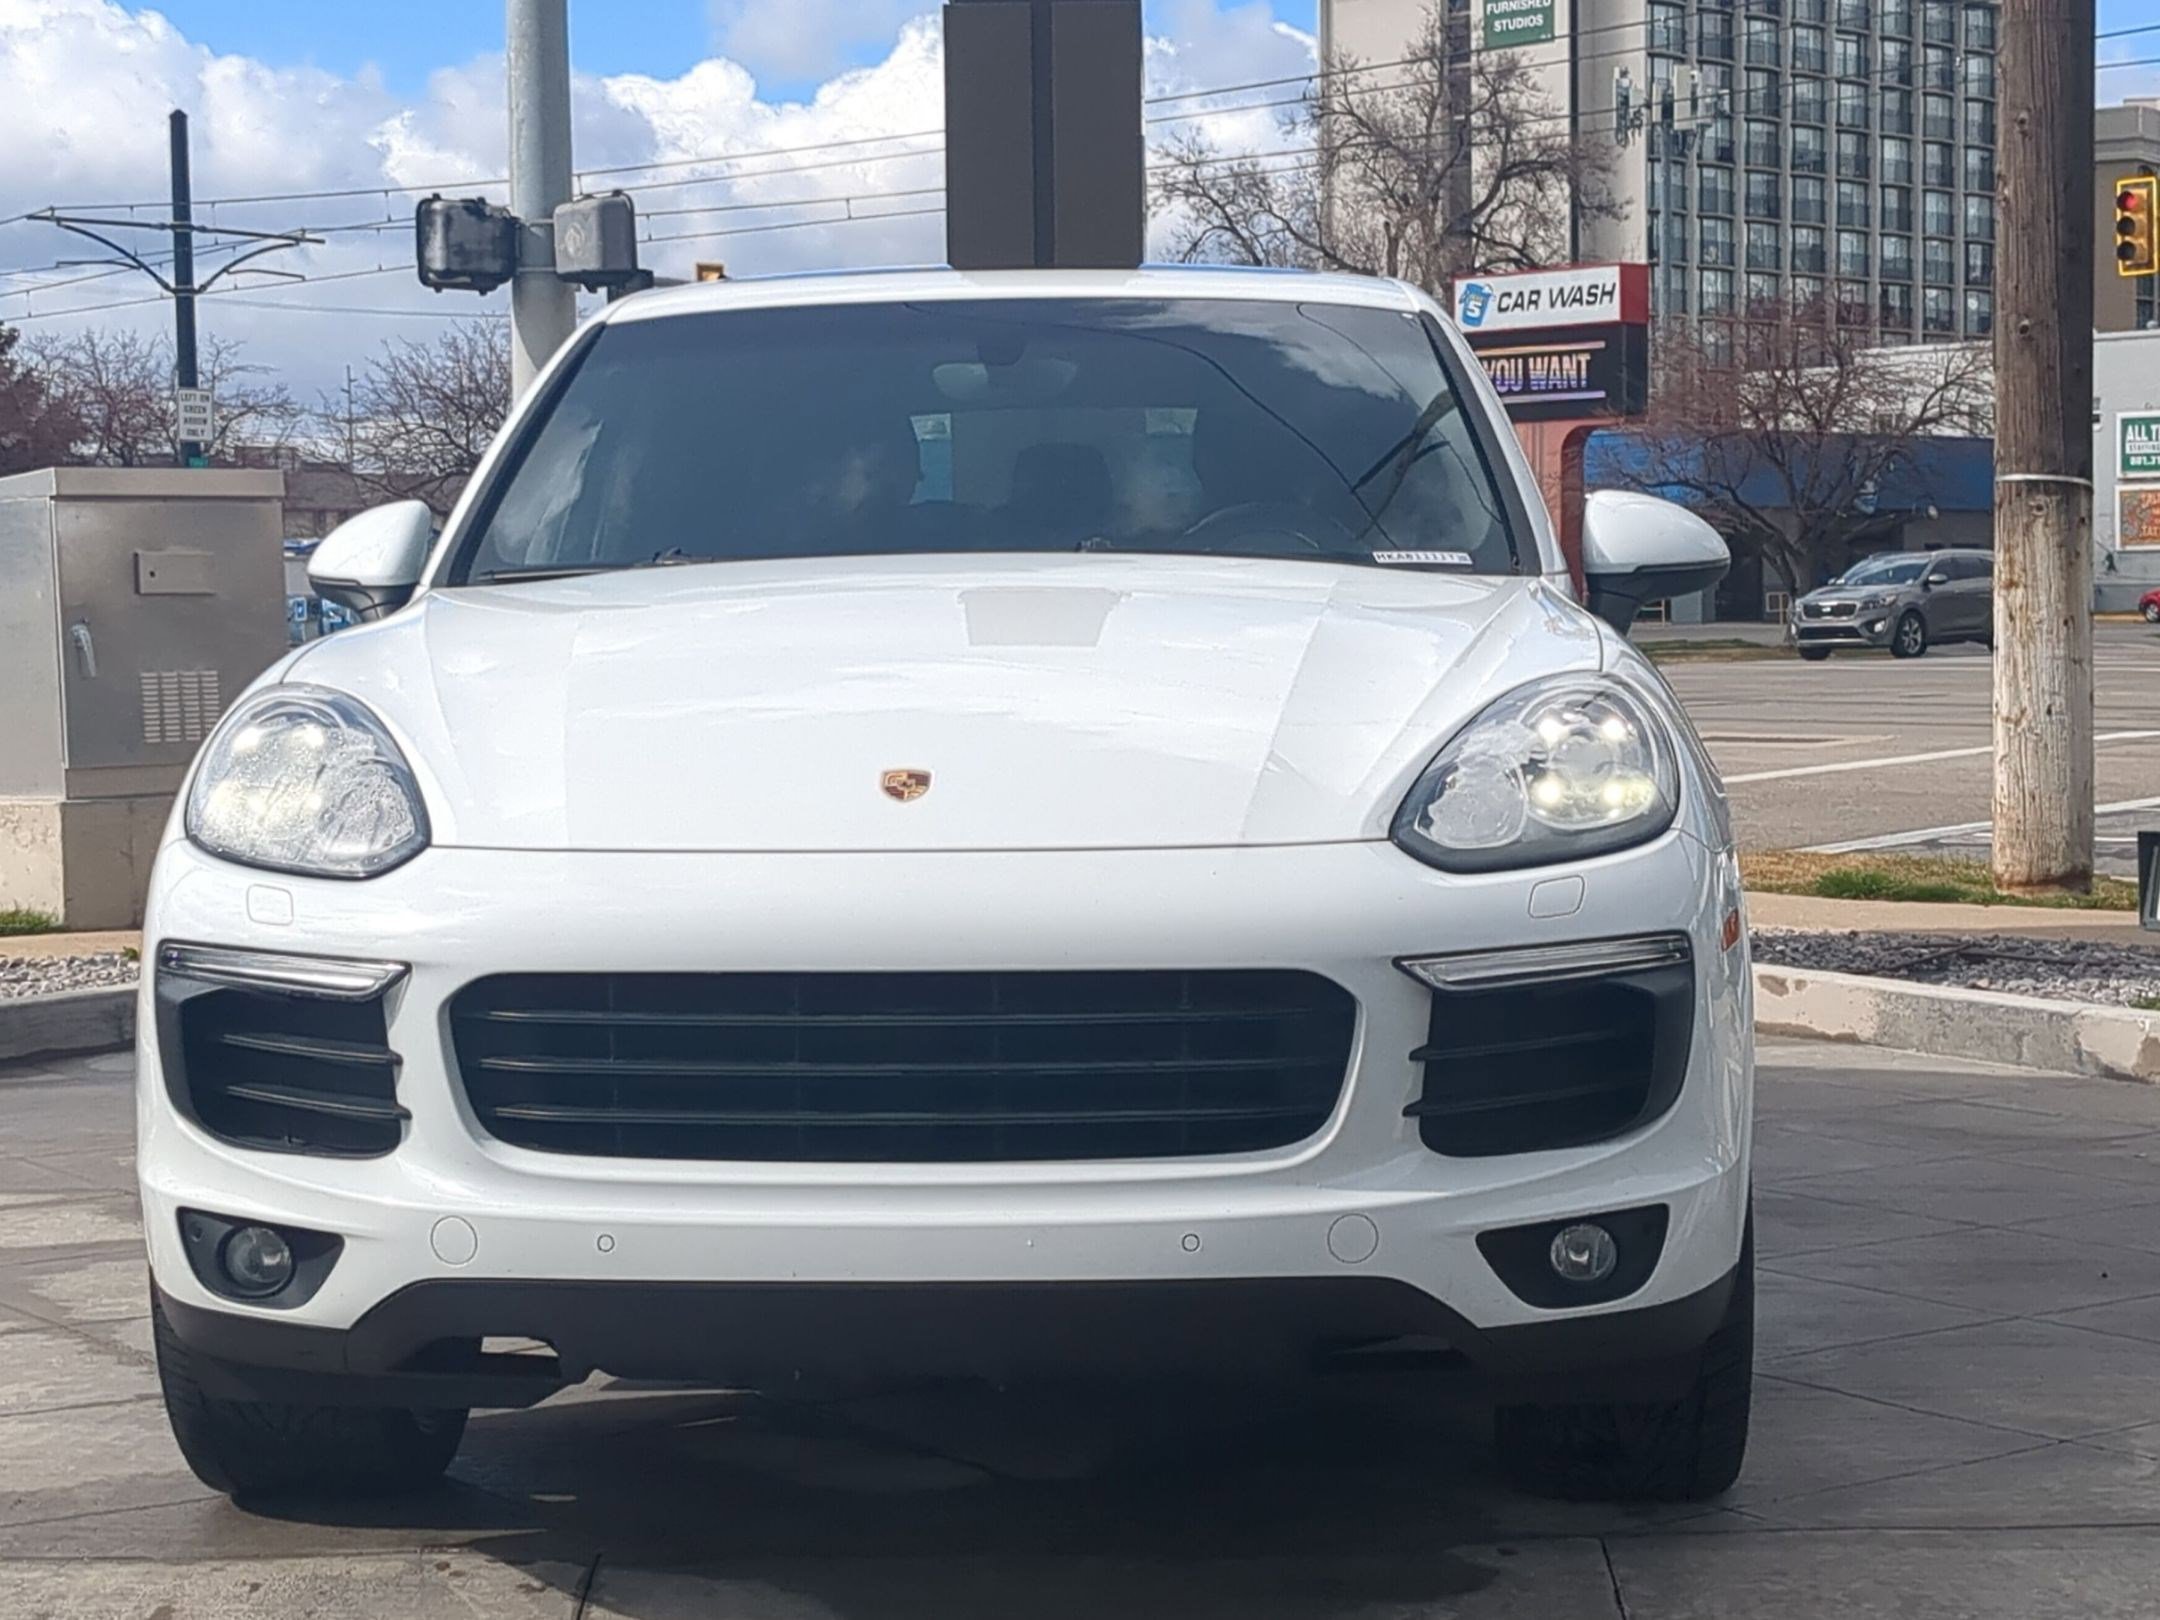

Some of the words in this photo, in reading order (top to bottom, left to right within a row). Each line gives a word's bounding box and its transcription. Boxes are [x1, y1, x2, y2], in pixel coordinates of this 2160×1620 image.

[1493, 14, 1544, 32] STUDIOS
[1497, 290, 1541, 313] CAR
[1549, 282, 1616, 309] WASH
[1482, 357, 1524, 393] YOU
[1529, 352, 1591, 390] WANT
[2126, 424, 2149, 440] ALL
